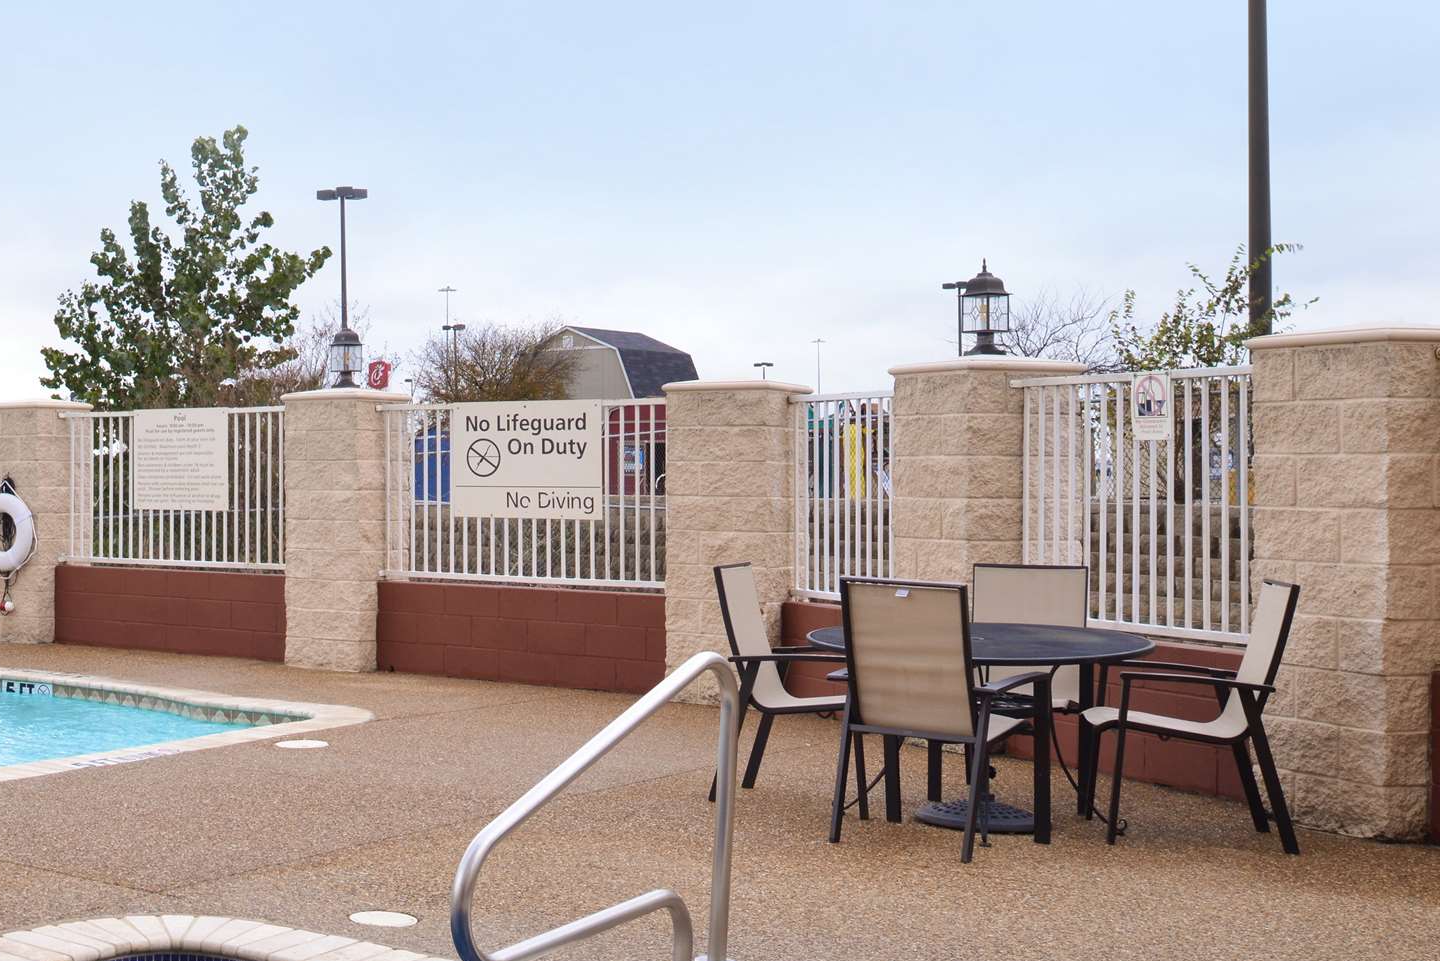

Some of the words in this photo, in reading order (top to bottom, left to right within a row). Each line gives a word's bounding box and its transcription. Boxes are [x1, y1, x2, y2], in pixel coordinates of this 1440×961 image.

[465, 415, 491, 432] No
[496, 412, 587, 436] Lifeguard
[507, 438, 535, 455] On
[541, 438, 588, 459] Duty
[505, 491, 531, 509] No
[537, 491, 594, 514] Diving
